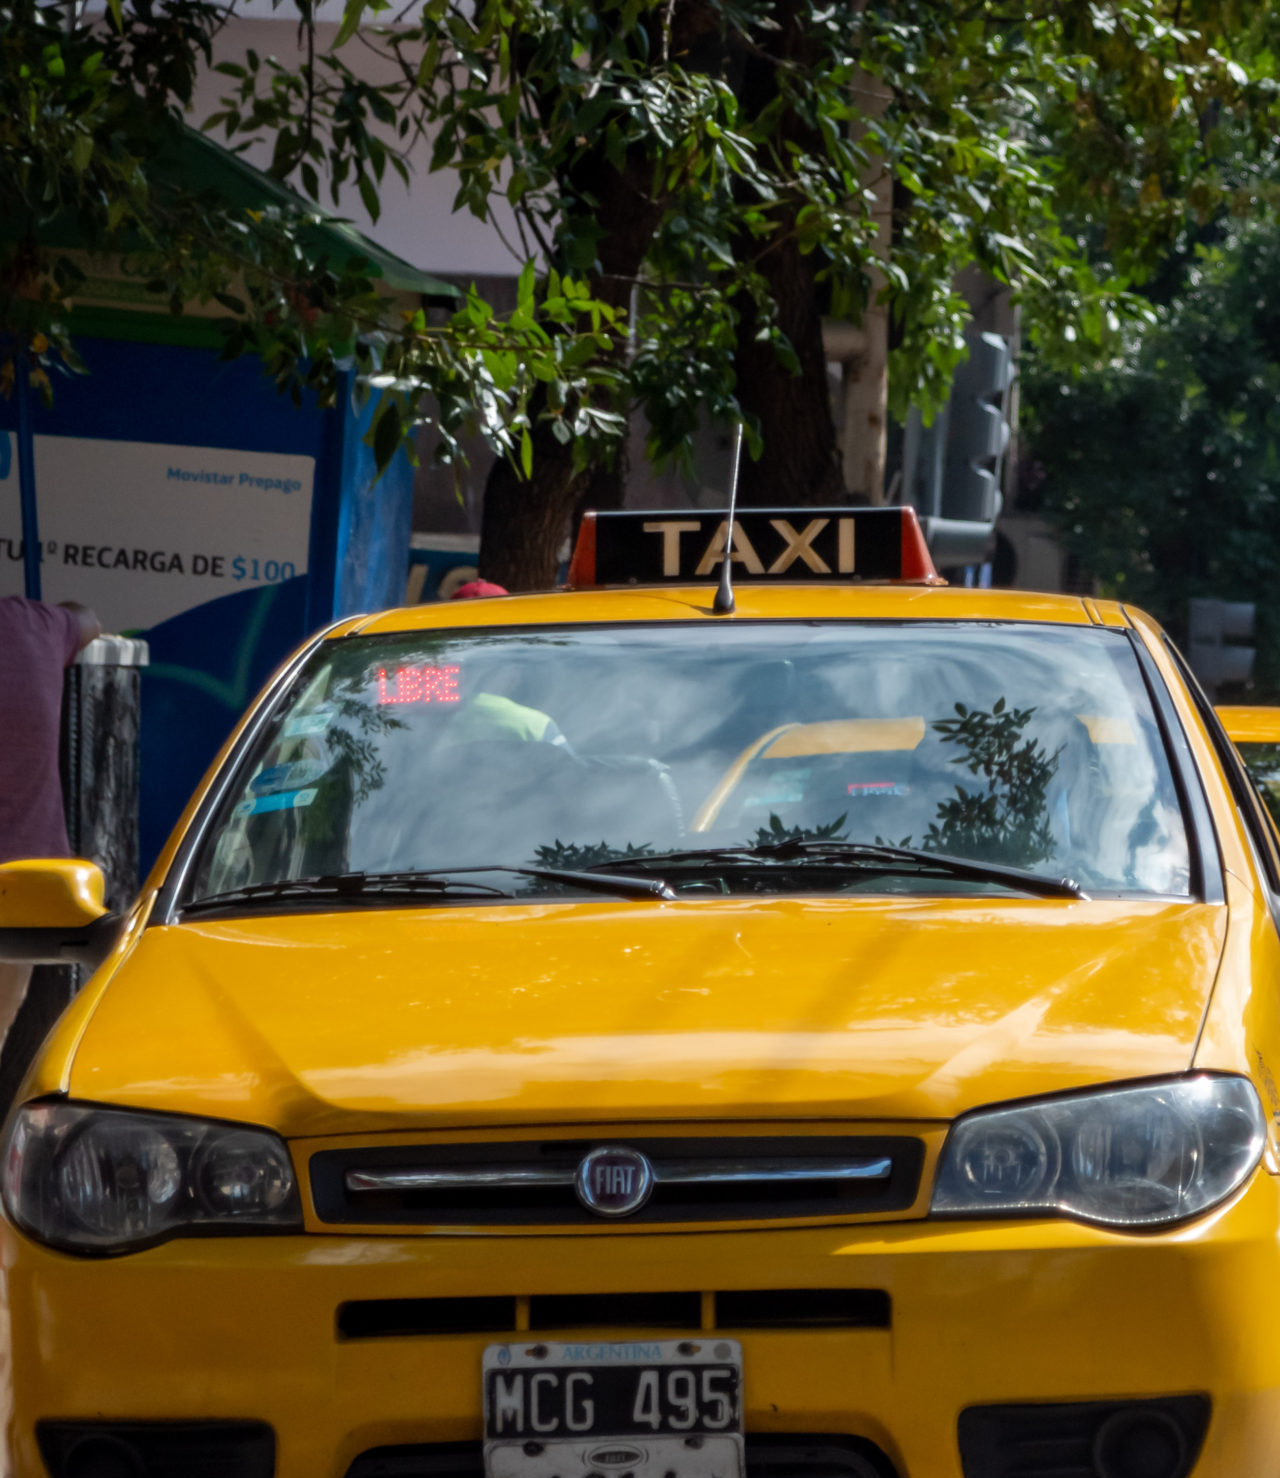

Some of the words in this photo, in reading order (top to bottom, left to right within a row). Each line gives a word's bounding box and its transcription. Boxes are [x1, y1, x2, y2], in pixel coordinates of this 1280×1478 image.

[167, 466, 235, 485] Movistar
[239, 472, 302, 494] Prepago
[63, 543, 185, 575] RECARGA
[191, 554, 226, 578] DE
[231, 555, 296, 582] $100
[642, 517, 856, 577] TAXI
[379, 667, 460, 703] LIBRE
[596, 1165, 637, 1196] FIAT
[560, 1344, 663, 1361] ARGENTINA
[495, 1371, 595, 1434] MCG
[632, 1369, 732, 1431] 495
